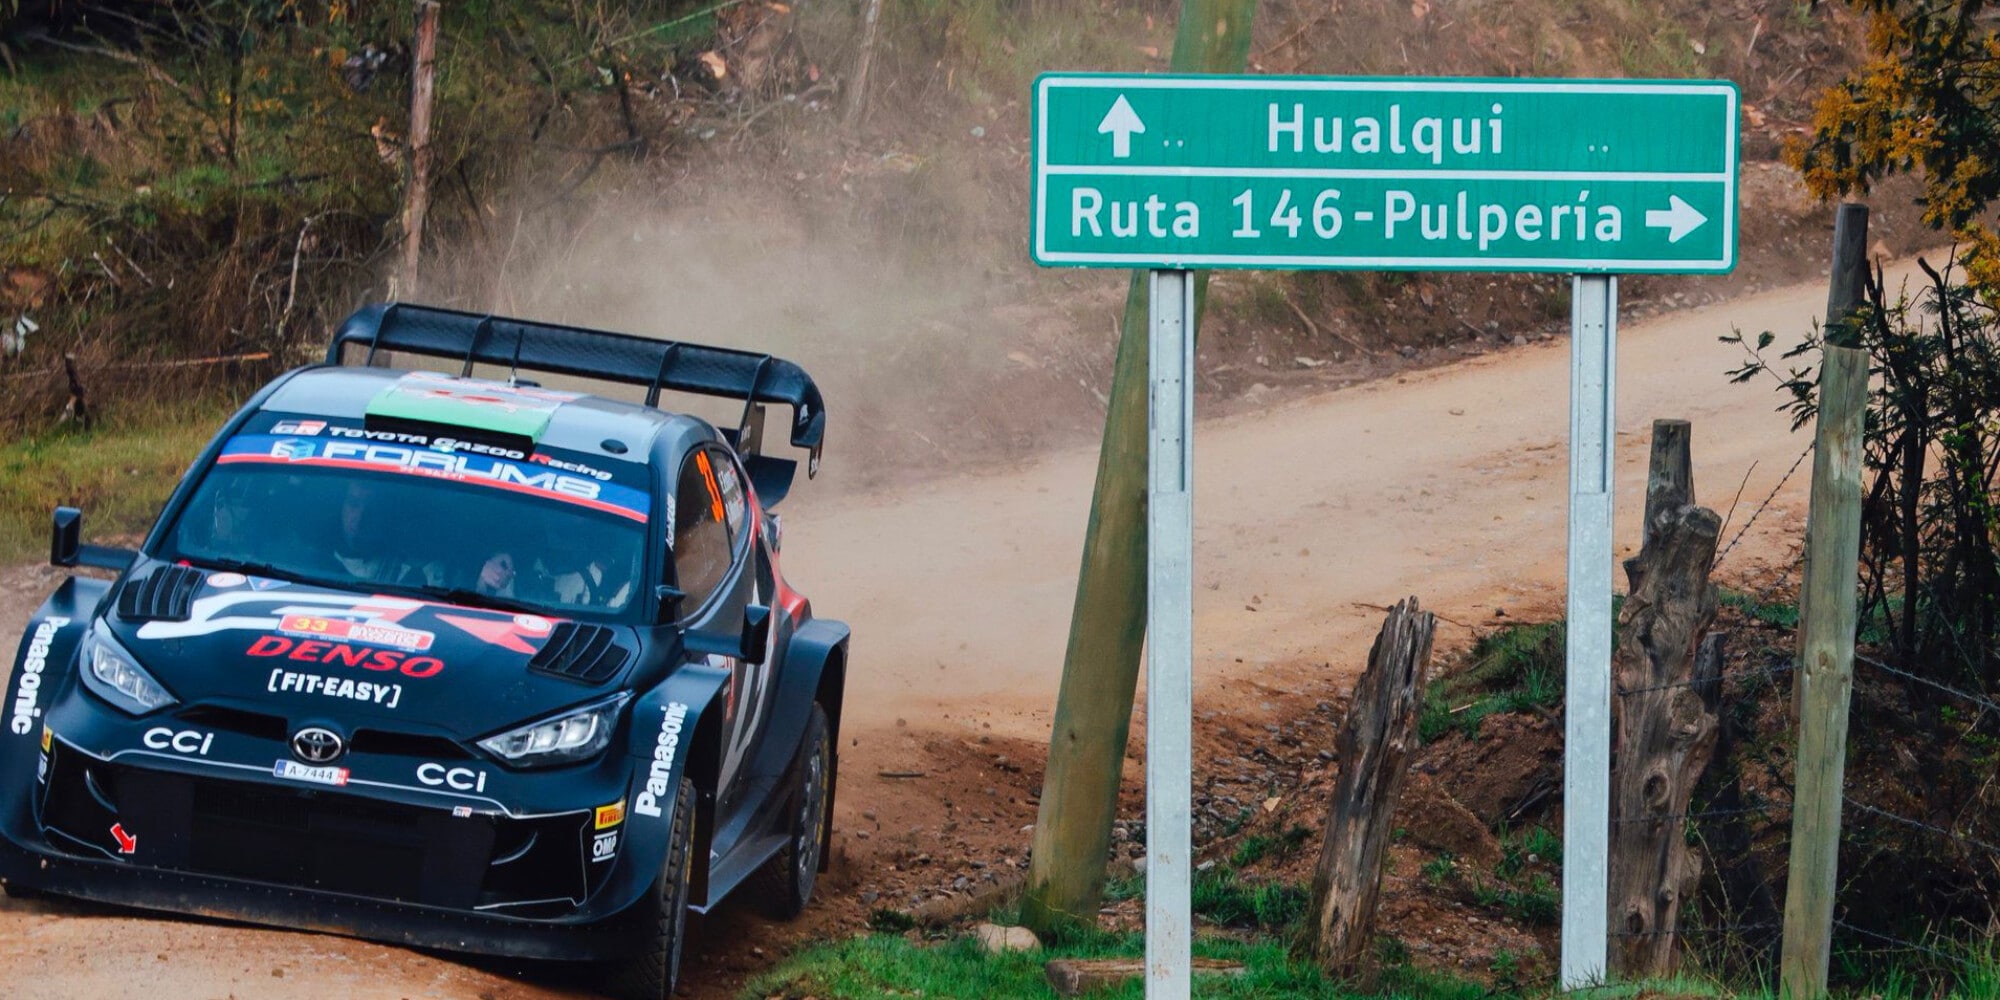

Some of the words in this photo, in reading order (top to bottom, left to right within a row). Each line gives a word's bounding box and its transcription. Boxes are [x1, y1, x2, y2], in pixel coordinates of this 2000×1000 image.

[1267, 103, 1503, 164] Hualqui
[1071, 188, 1201, 238] Ruta
[1231, 188, 1624, 250] 146-Pulpería
[322, 441, 601, 500] FORUM8
[329, 426, 428, 445] TOYOTA
[433, 437, 525, 460] GAZOO
[529, 452, 613, 482] Racing
[292, 617, 329, 633] 33
[11, 616, 71, 735] Panasonic
[246, 635, 444, 678] DENSO
[416, 762, 487, 793] CCI
[634, 701, 689, 818] Panasonic
[593, 834, 617, 858] OMP
